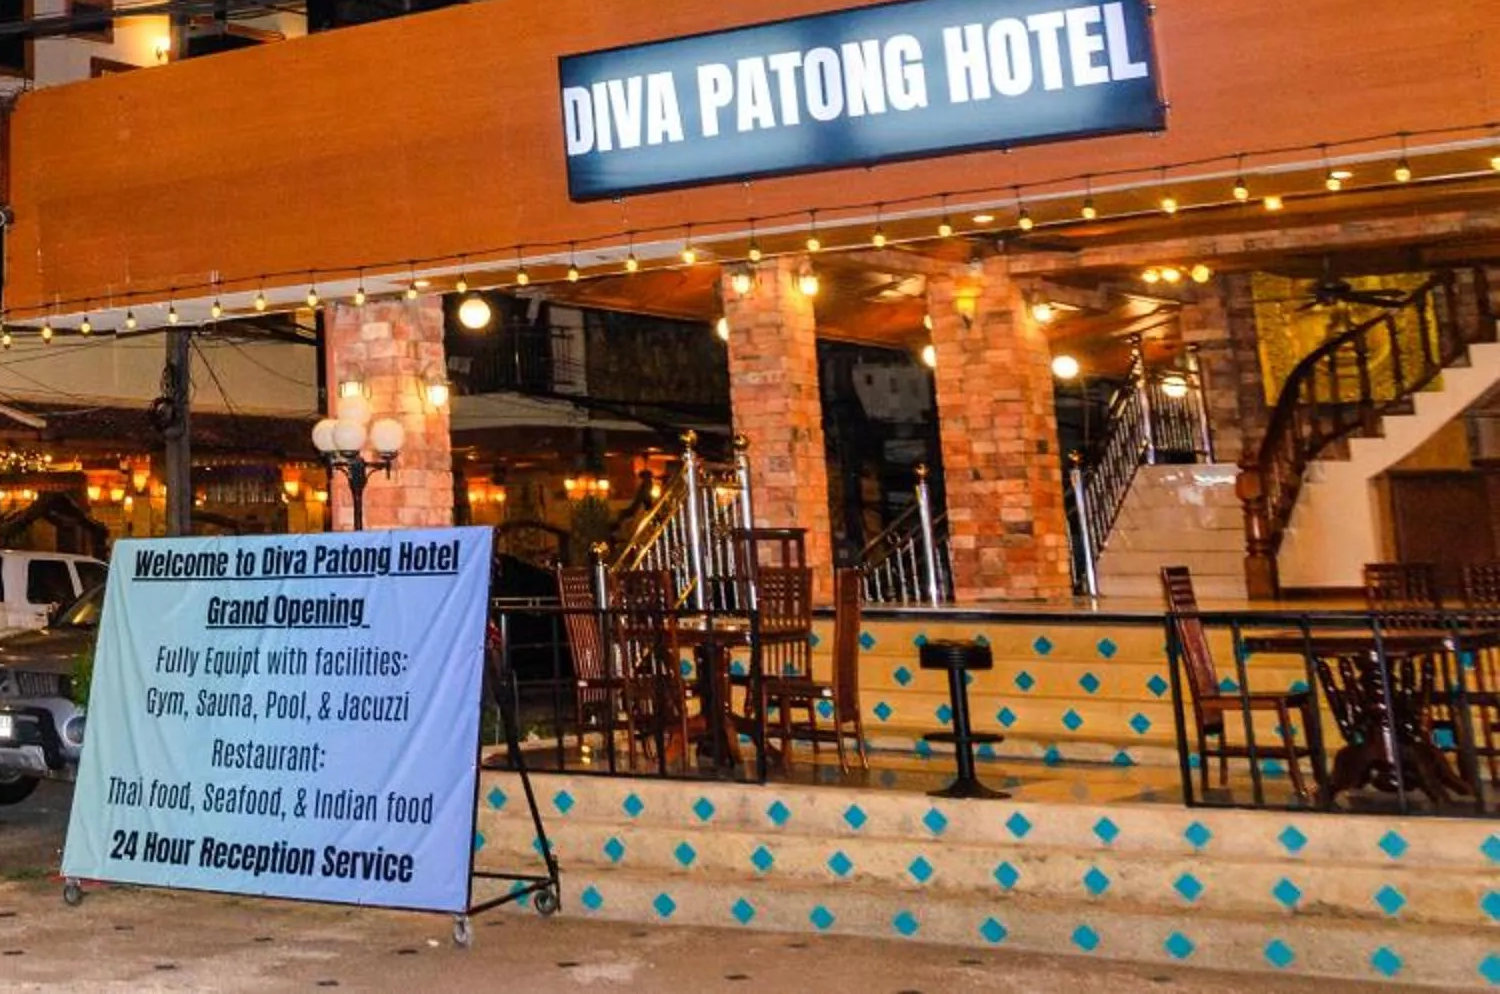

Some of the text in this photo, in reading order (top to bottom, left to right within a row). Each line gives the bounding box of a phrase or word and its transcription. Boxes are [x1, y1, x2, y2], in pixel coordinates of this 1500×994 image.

[562, 1, 1148, 156] DIVA PATONG HOTEL
[135, 540, 459, 578] Welcome to Diva Patong Hotel
[207, 593, 365, 628] Grand Opening
[155, 645, 409, 677] Fully Equipt with facilities:
[147, 687, 409, 722] Gym, Sauna, Pool, & Jacuzzi
[211, 738, 326, 773] Restaurant:
[107, 776, 433, 825] Thai food, Seafood, & Indian food
[111, 829, 414, 883] 24 Hour Reception Service
